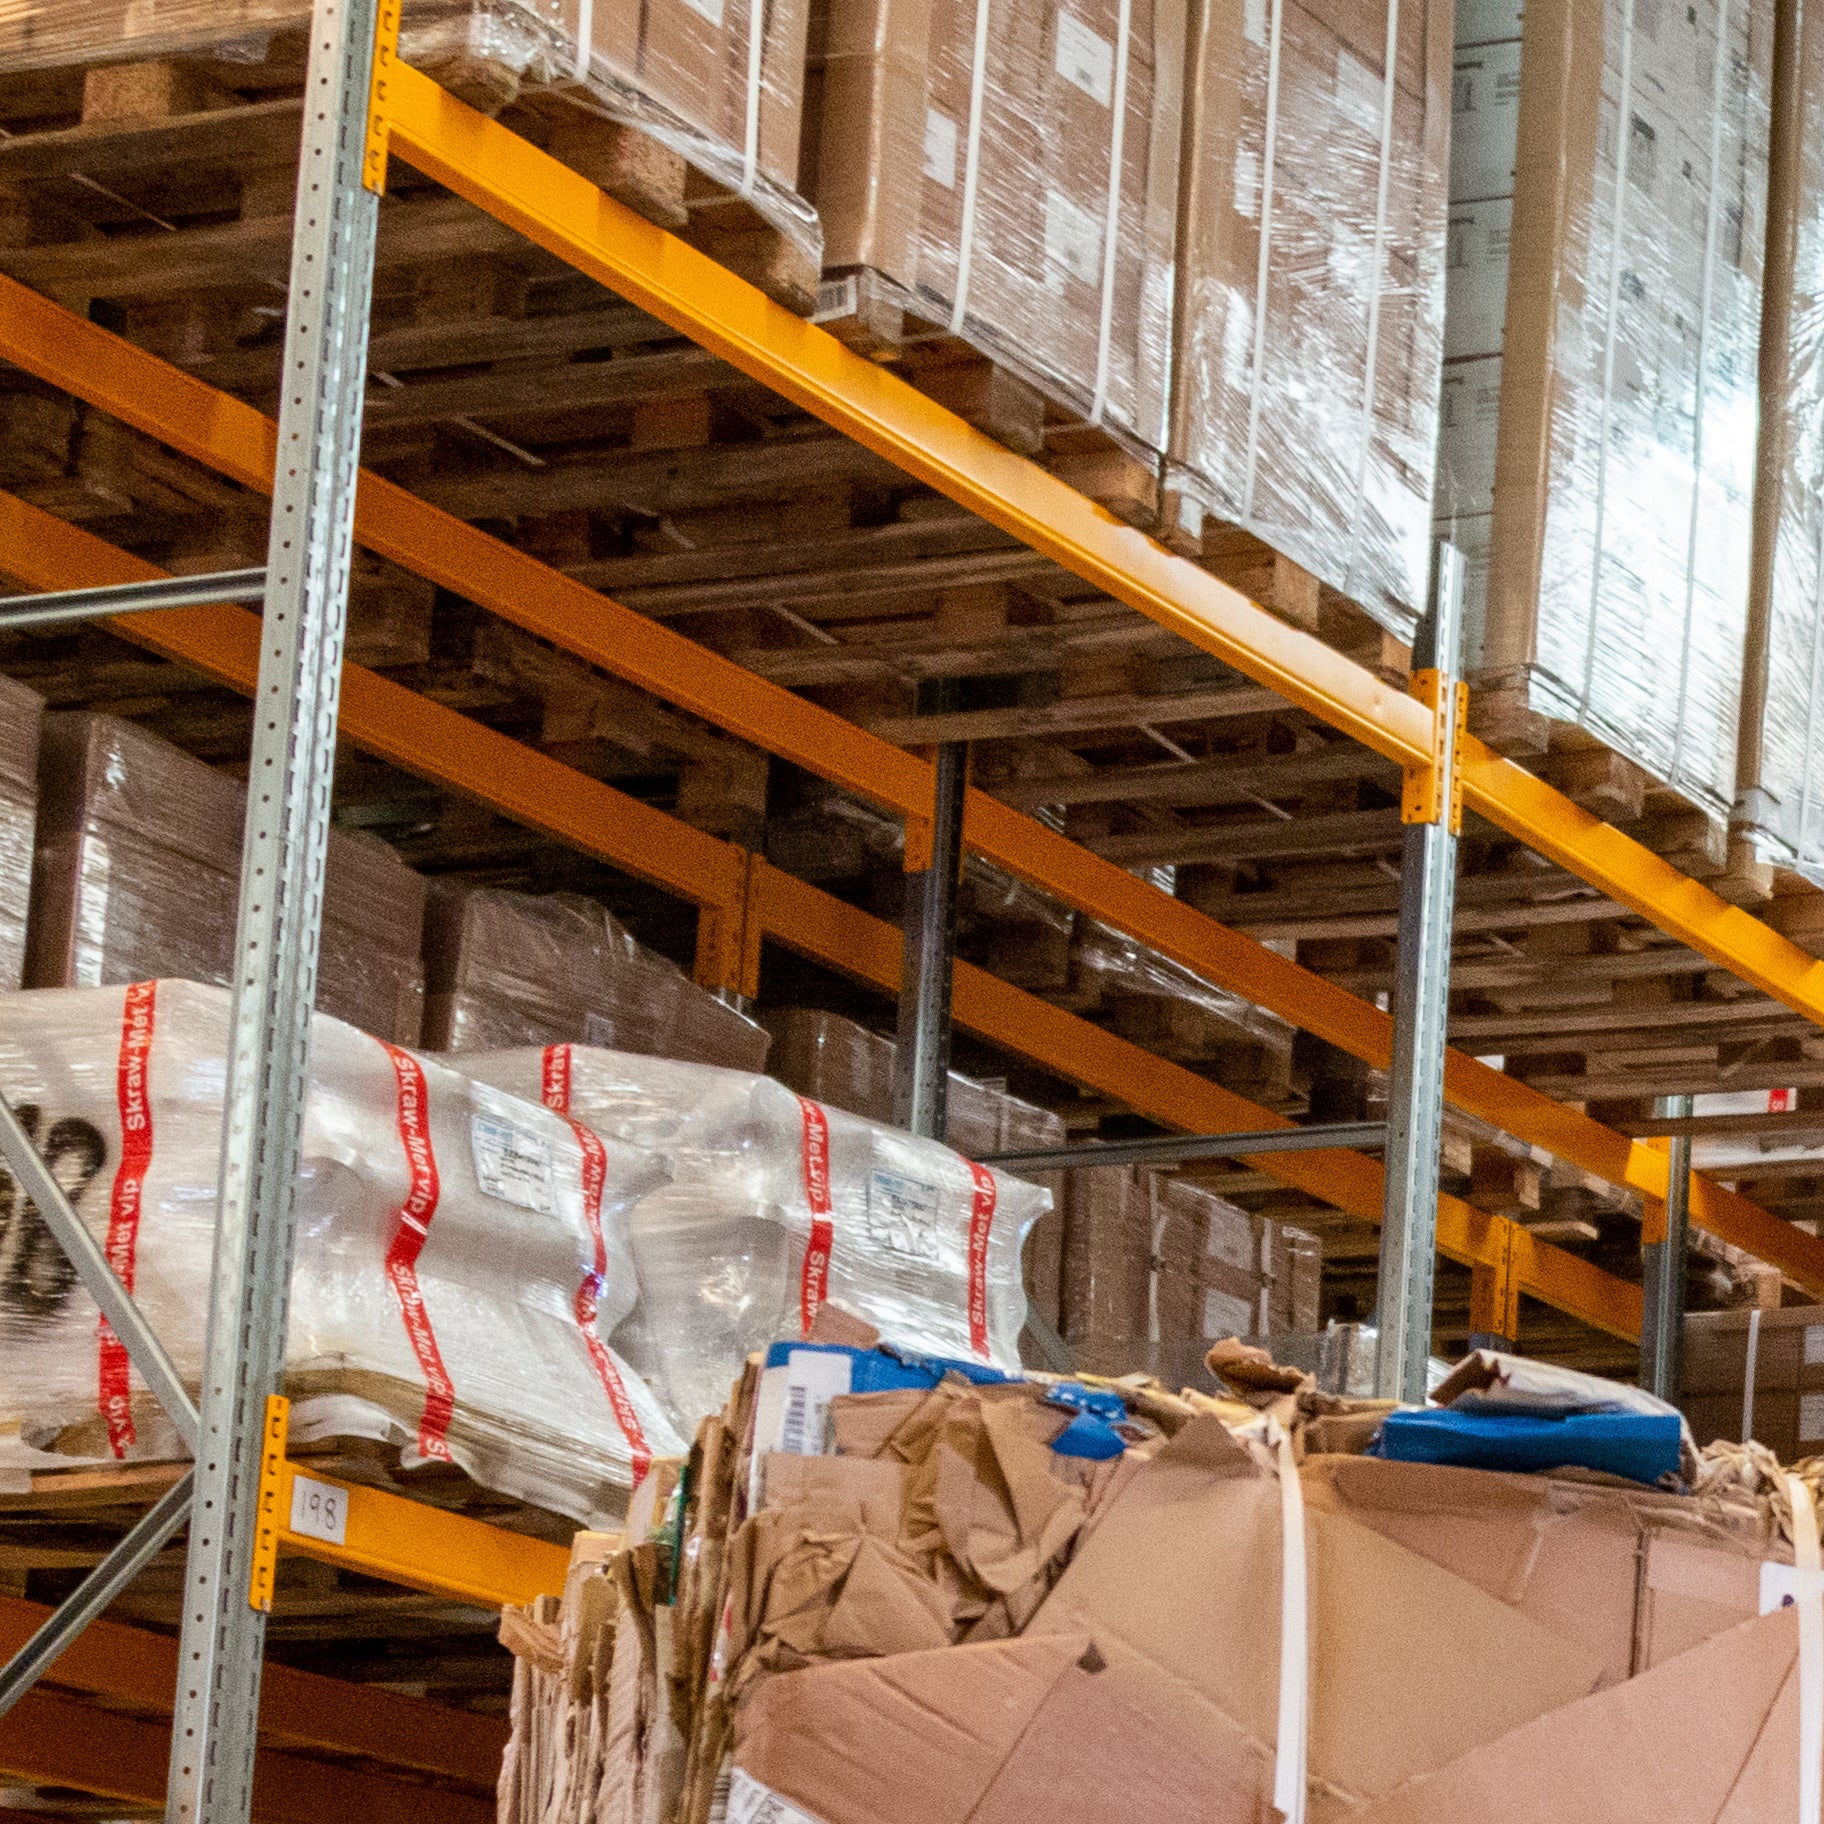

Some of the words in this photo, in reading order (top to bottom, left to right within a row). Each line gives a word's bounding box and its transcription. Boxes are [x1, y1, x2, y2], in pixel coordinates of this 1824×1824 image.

[126, 1006, 149, 1131] Skraw-Met
[394, 1055, 431, 1172] Skraw-Met
[410, 1176, 434, 1214] vip
[971, 1212, 991, 1326] Skraw-Met
[300, 1489, 337, 1531] 198
